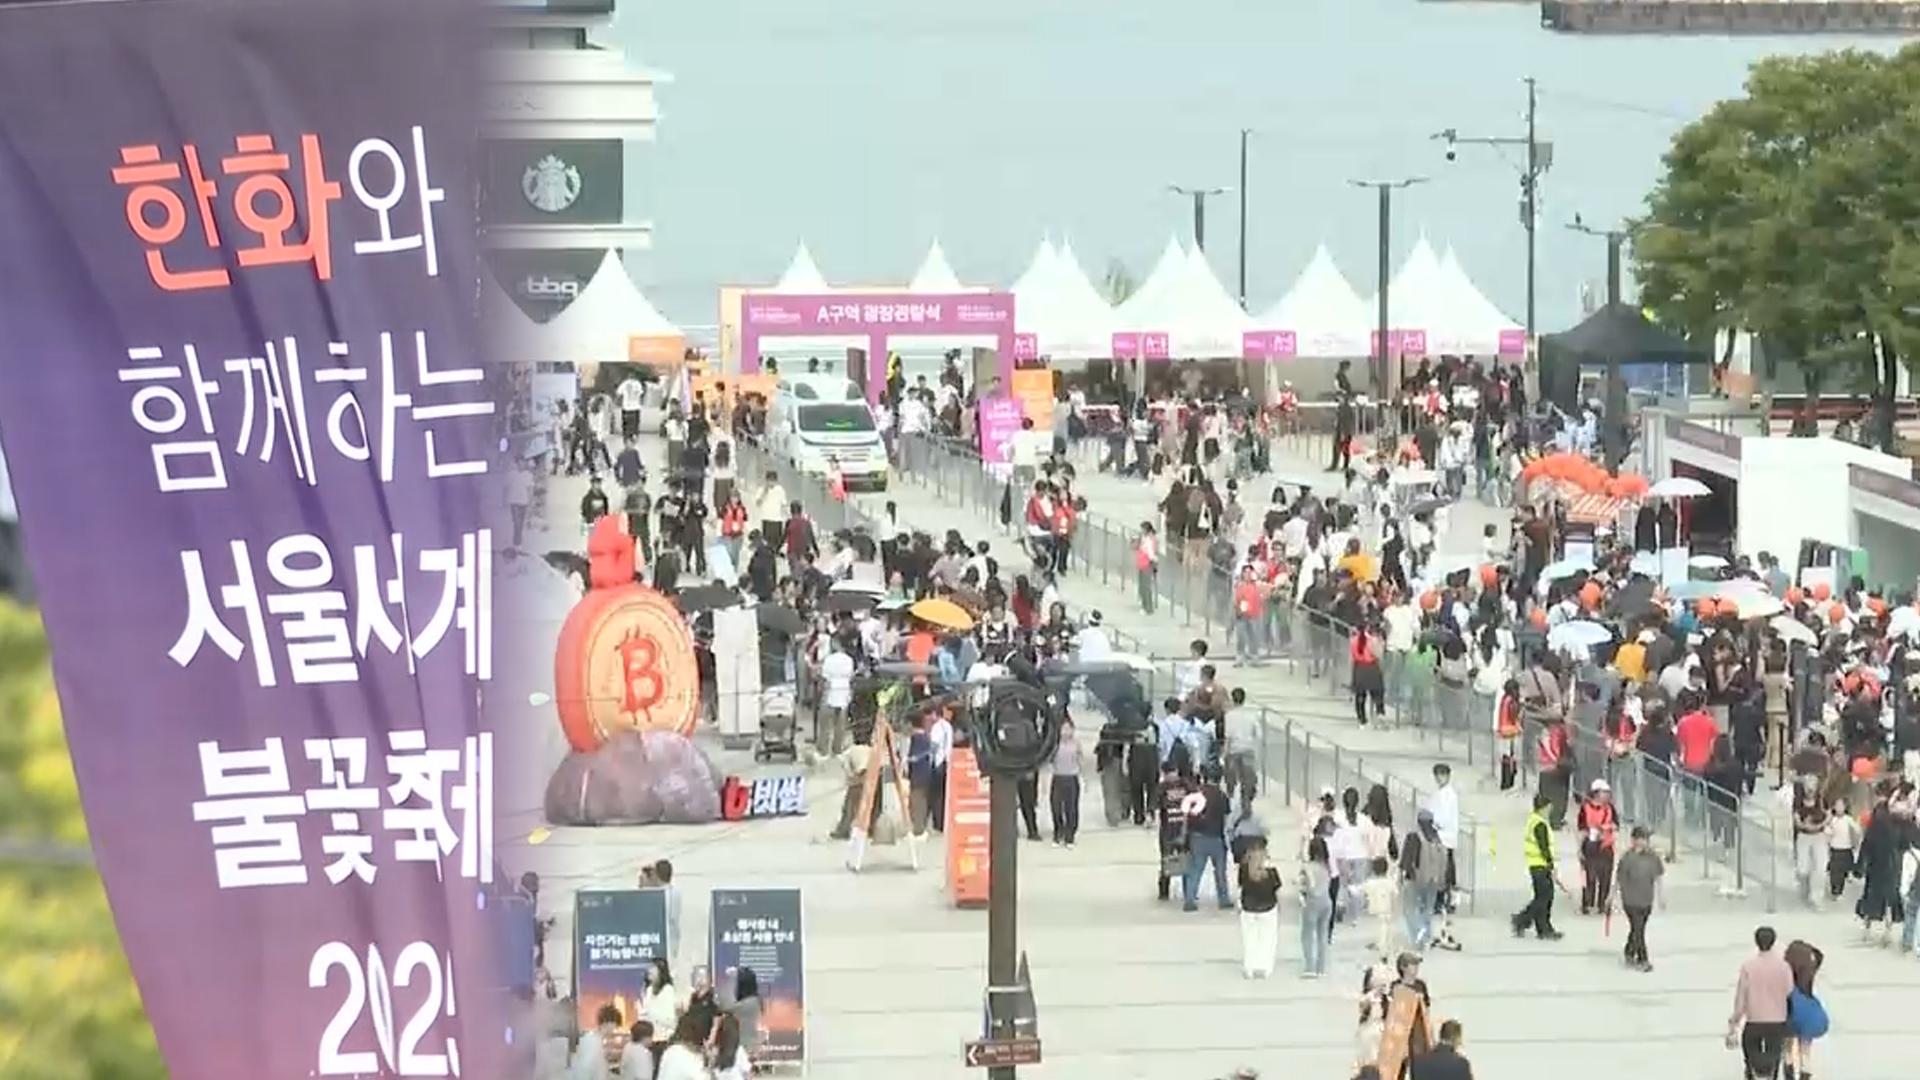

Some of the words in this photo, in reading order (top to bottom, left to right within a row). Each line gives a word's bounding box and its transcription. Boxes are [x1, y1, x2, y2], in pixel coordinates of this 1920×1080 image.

[111, 125, 446, 291] 한화와
[527, 278, 578, 297] bbq
[816, 303, 860, 325] A구역
[118, 330, 496, 493] 함께하는
[192, 729, 493, 888] 불꽃축제
